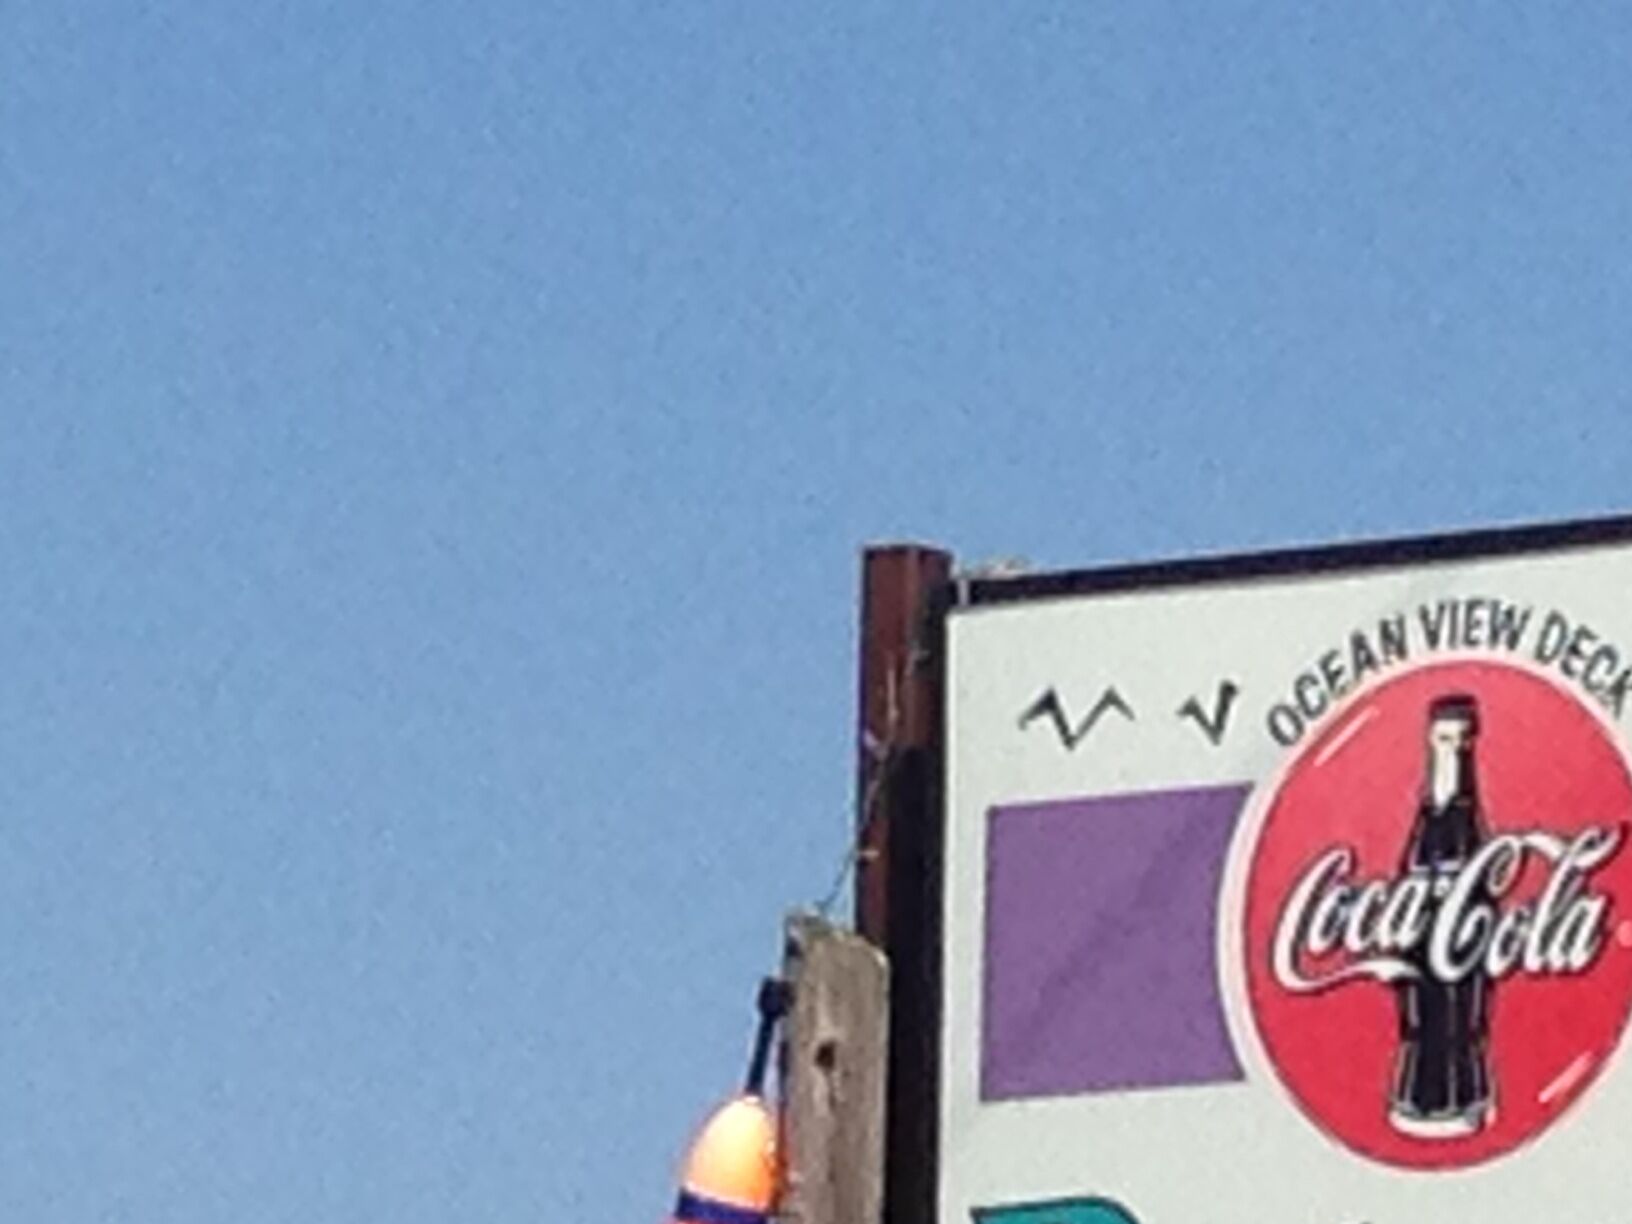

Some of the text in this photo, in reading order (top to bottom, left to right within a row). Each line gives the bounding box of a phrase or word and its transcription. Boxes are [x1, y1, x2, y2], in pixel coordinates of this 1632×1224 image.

[1266, 608, 1408, 747] OCEAN
[1419, 597, 1530, 652] VIEW
[1272, 823, 1629, 993] Coca-Cola
